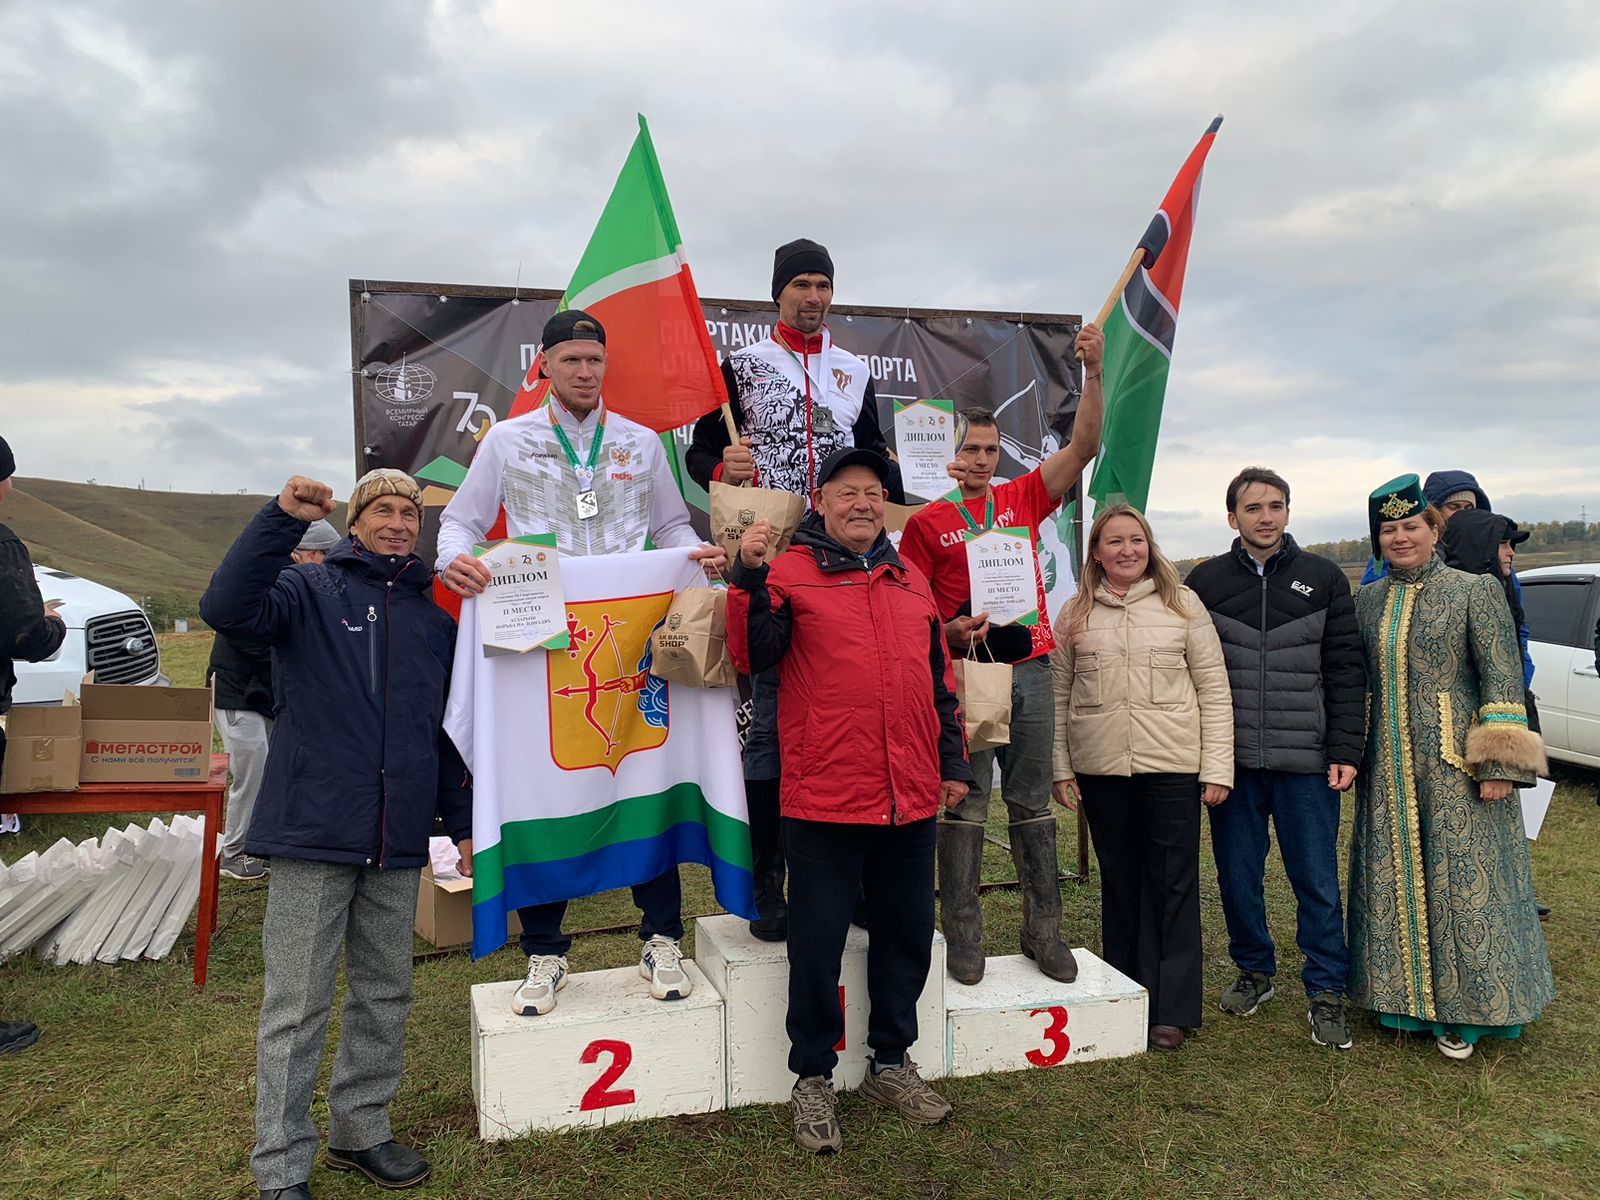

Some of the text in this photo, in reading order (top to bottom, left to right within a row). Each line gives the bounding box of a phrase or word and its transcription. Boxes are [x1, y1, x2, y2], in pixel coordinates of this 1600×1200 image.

[386, 407, 428, 416] ВСЕМИРНЫЙ
[904, 432, 946, 443] ДИПЛОМ
[978, 557, 1024, 569] ДИПЛОМ
[488, 571, 548, 588] ДИПЛОМ
[1290, 580, 1314, 593] EA7
[511, 605, 541, 615] МЕСТО
[659, 640, 685, 648] SHOP
[1025, 1006, 1071, 1067] 3
[579, 1039, 636, 1112] 2
